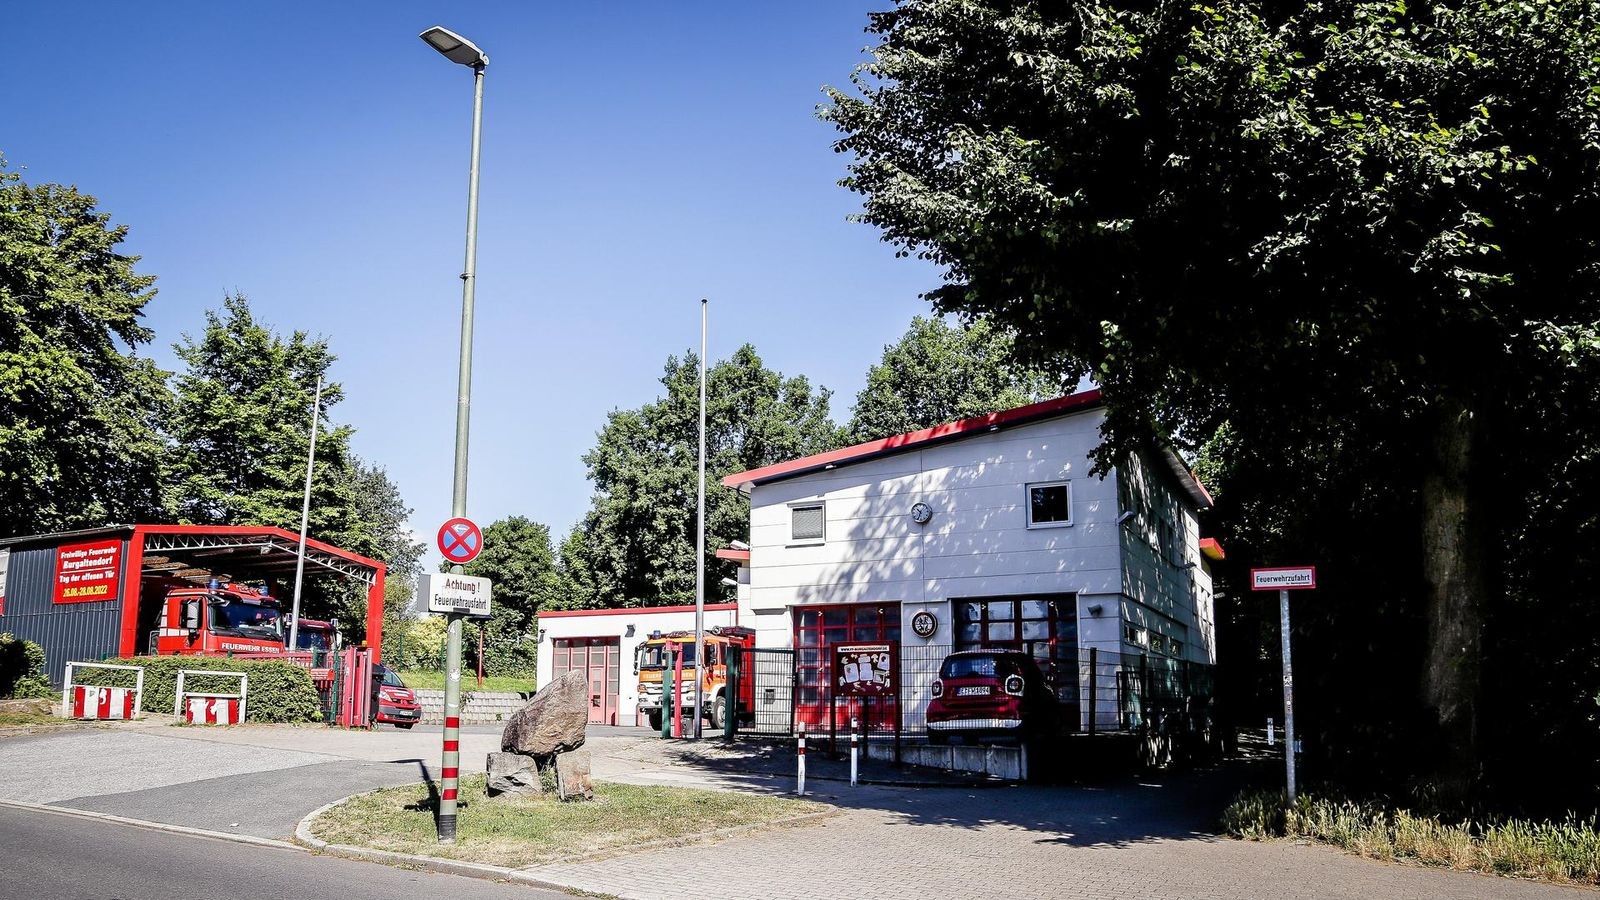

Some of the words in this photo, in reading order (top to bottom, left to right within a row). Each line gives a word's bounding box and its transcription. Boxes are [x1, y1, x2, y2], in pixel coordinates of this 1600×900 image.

[61, 549, 87, 559] Freiwillige
[88, 546, 117, 556] Feuerwehr
[63, 556, 113, 569] Burgaltendorf
[60, 575, 70, 584] Tag
[70, 574, 80, 582] der
[81, 572, 103, 581] offenen
[105, 570, 115, 579] Tür
[1256, 574, 1310, 583] Feuerwehrzufahrt
[445, 578, 476, 595] Achtung
[434, 593, 487, 610] Feuerwehrausfahrt
[221, 642, 260, 652] FEUERWEHR
[261, 646, 280, 654] ESSEN
